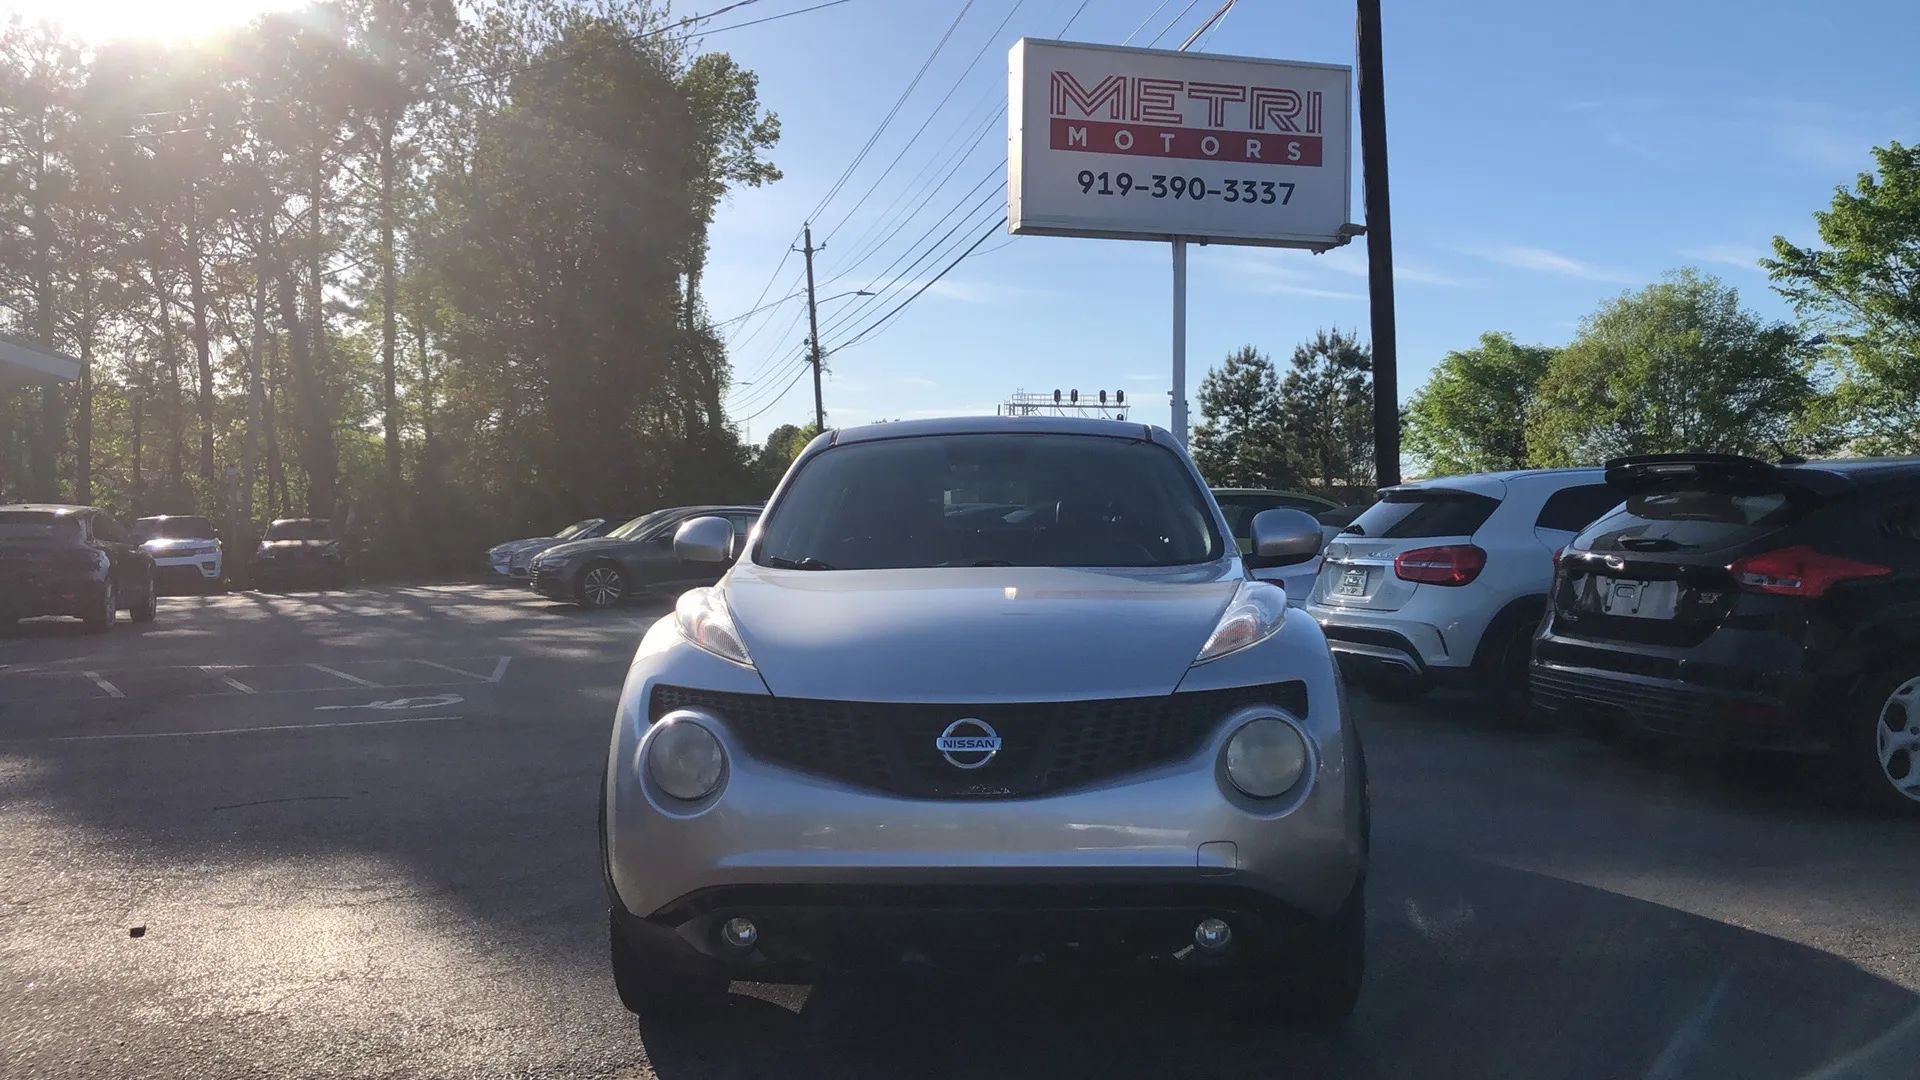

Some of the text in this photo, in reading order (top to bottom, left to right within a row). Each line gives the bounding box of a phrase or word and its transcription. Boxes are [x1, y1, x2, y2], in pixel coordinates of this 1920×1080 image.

[1050, 71, 1322, 133] METRI
[1068, 126, 1301, 162] MOTORS
[1077, 170, 1296, 205] 919-390-3337
[943, 739, 995, 749] NISSAN
